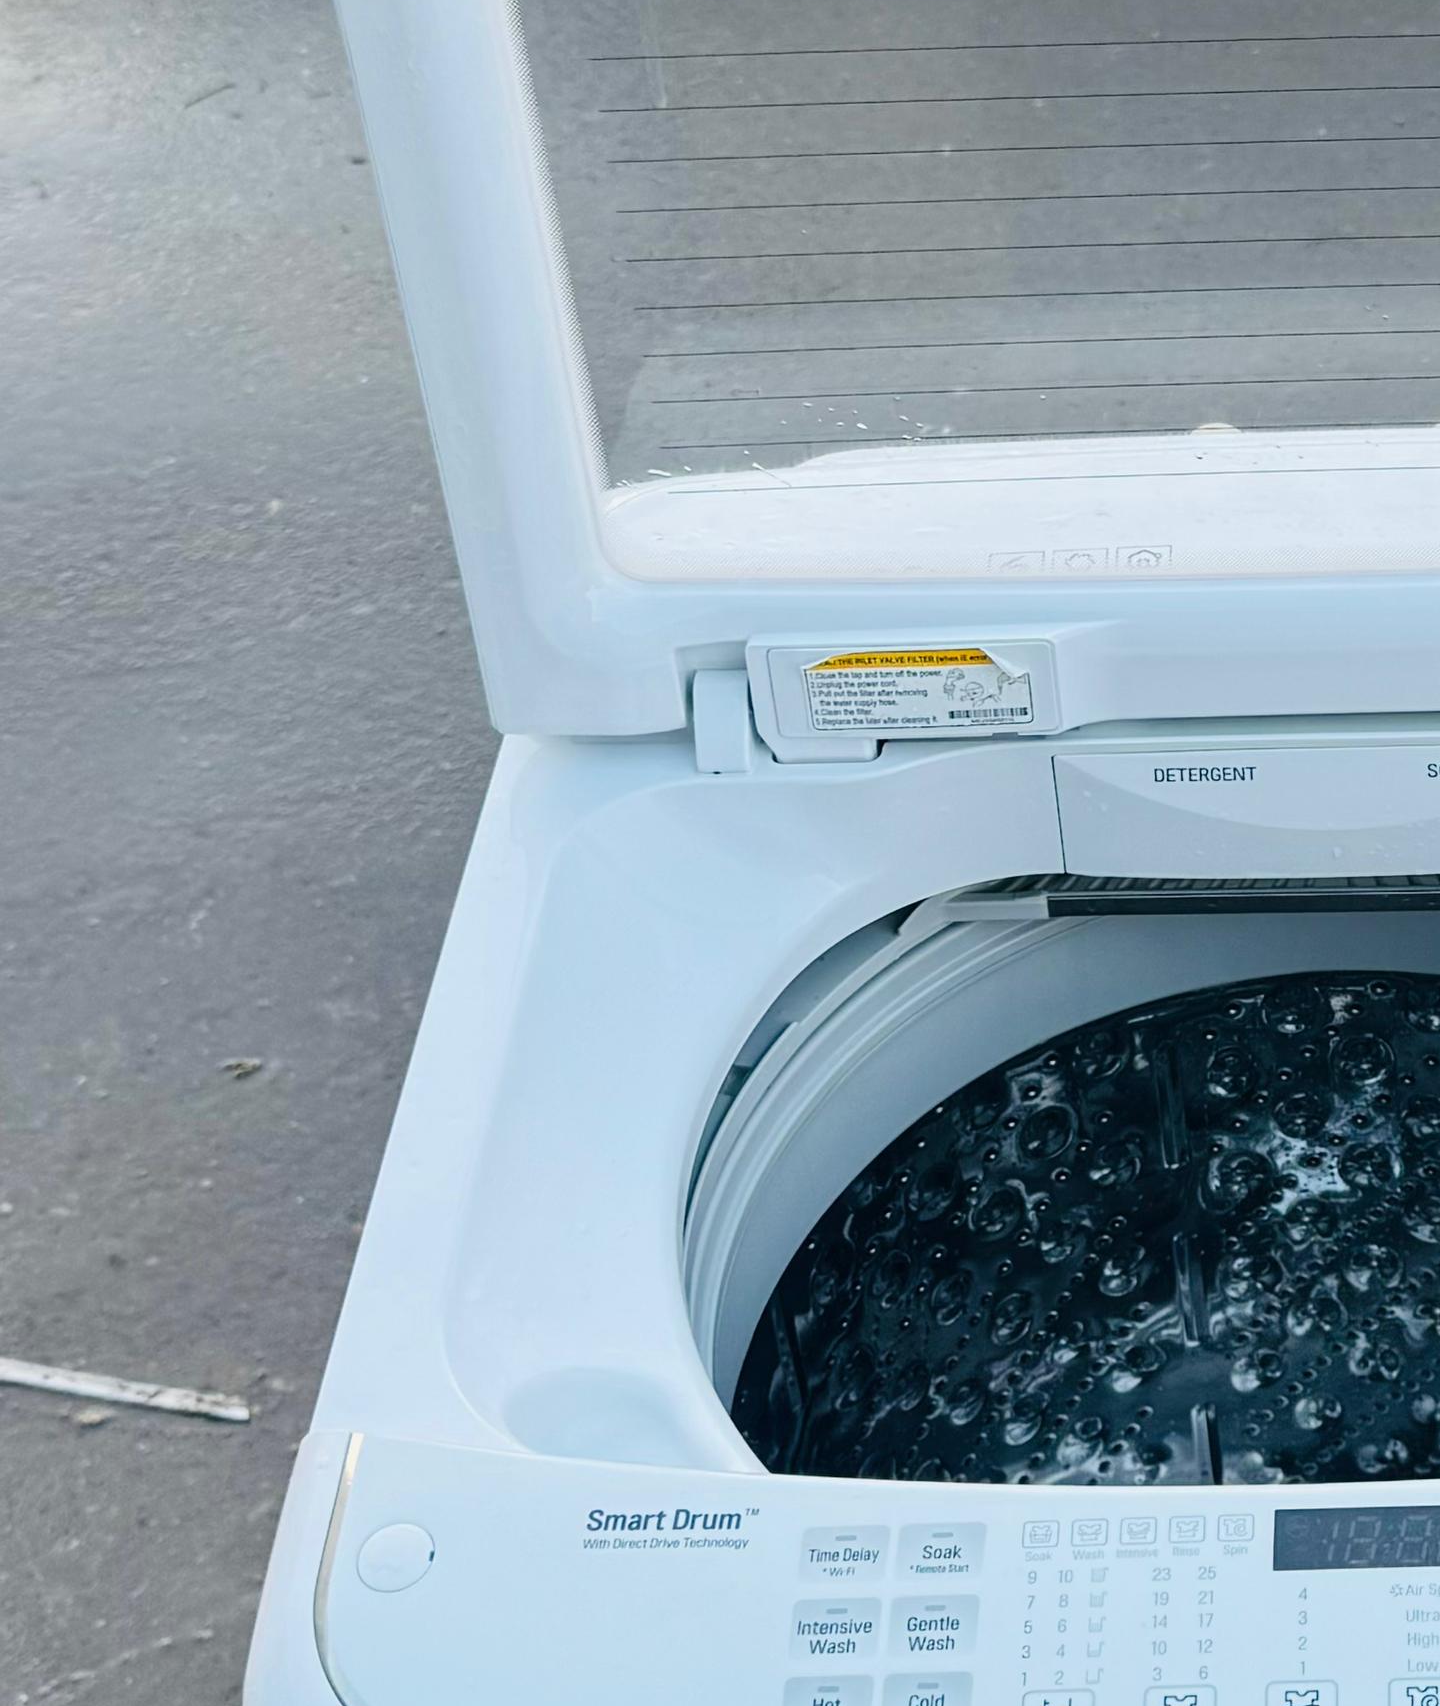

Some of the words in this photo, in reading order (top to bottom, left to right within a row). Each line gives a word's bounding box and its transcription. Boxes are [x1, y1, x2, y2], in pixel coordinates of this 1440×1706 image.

[880, 656, 905, 664] VALVE
[907, 656, 934, 664] FILTER
[858, 681, 878, 689] power
[1153, 766, 1257, 783] DETERGENT
[586, 1509, 666, 1532] Smart
[583, 1538, 611, 1549] With
[613, 1537, 647, 1549] Direct
[650, 1537, 680, 1549] Drive
[684, 1537, 749, 1550] Technology
[1223, 1544, 1249, 1556] Spin
[809, 1549, 840, 1563] Time
[843, 1548, 880, 1564] Delay
[922, 1545, 962, 1560] Soak
[1025, 1550, 1054, 1562] Soak
[1072, 1548, 1105, 1560] Wash
[1027, 1571, 1037, 1584] 9
[1058, 1569, 1074, 1583] 10
[1151, 1567, 1172, 1581] 23
[1197, 1566, 1217, 1580] 25
[1298, 1588, 1308, 1601] 4
[1405, 1583, 1425, 1596] Air
[1026, 1595, 1035, 1609] 7
[1059, 1594, 1069, 1608] 8
[1153, 1592, 1169, 1606] 19
[1197, 1591, 1215, 1605] 21
[1152, 1614, 1168, 1628] 14
[1199, 1613, 1214, 1627] 17
[1298, 1612, 1307, 1625] 3
[1405, 1609, 1440, 1623] Ultra
[797, 1619, 873, 1637] Intensive
[907, 1616, 960, 1632] Gentle
[1023, 1620, 1033, 1634] 5
[1057, 1619, 1067, 1633] 6
[908, 1636, 957, 1652] Wash
[1198, 1639, 1213, 1653] 12
[1298, 1637, 1307, 1650] 2
[1407, 1632, 1440, 1648] High
[809, 1640, 857, 1655] Wash
[1021, 1645, 1031, 1659] 3
[1056, 1644, 1065, 1658] 4
[1152, 1641, 1167, 1655] 10
[1199, 1666, 1208, 1680] 6
[1407, 1659, 1439, 1673] Low
[1021, 1672, 1027, 1686] 1
[1054, 1671, 1064, 1685] 2
[1152, 1667, 1162, 1681] 3
